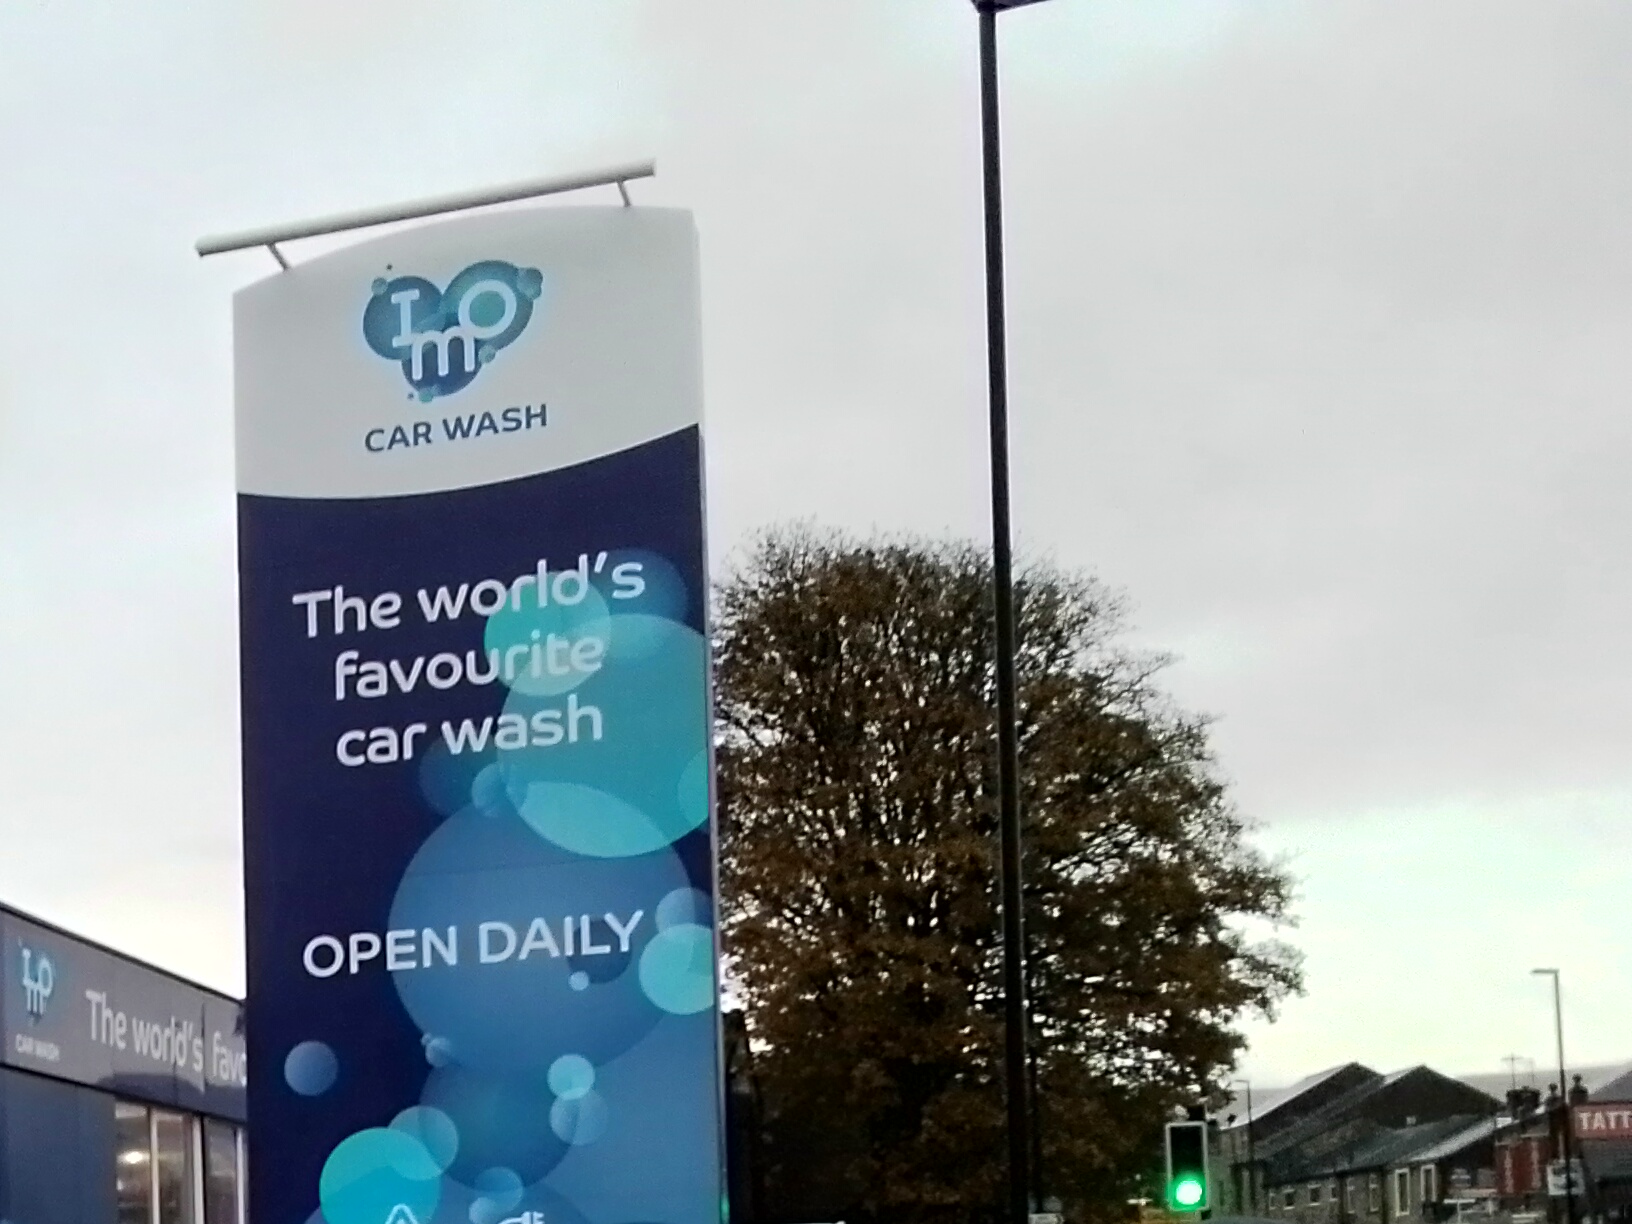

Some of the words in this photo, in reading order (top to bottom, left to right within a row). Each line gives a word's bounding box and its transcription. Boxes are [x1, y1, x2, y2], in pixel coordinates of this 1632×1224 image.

[364, 421, 432, 452] CAR
[442, 403, 548, 441] WASH
[292, 585, 402, 638] The
[417, 551, 645, 623] world's
[334, 629, 603, 700] favourite
[336, 723, 427, 767] car
[441, 693, 602, 755] wash
[302, 925, 458, 978] OPEN
[478, 909, 644, 965] DAILY
[85, 988, 128, 1050] The
[132, 1015, 204, 1072] world's
